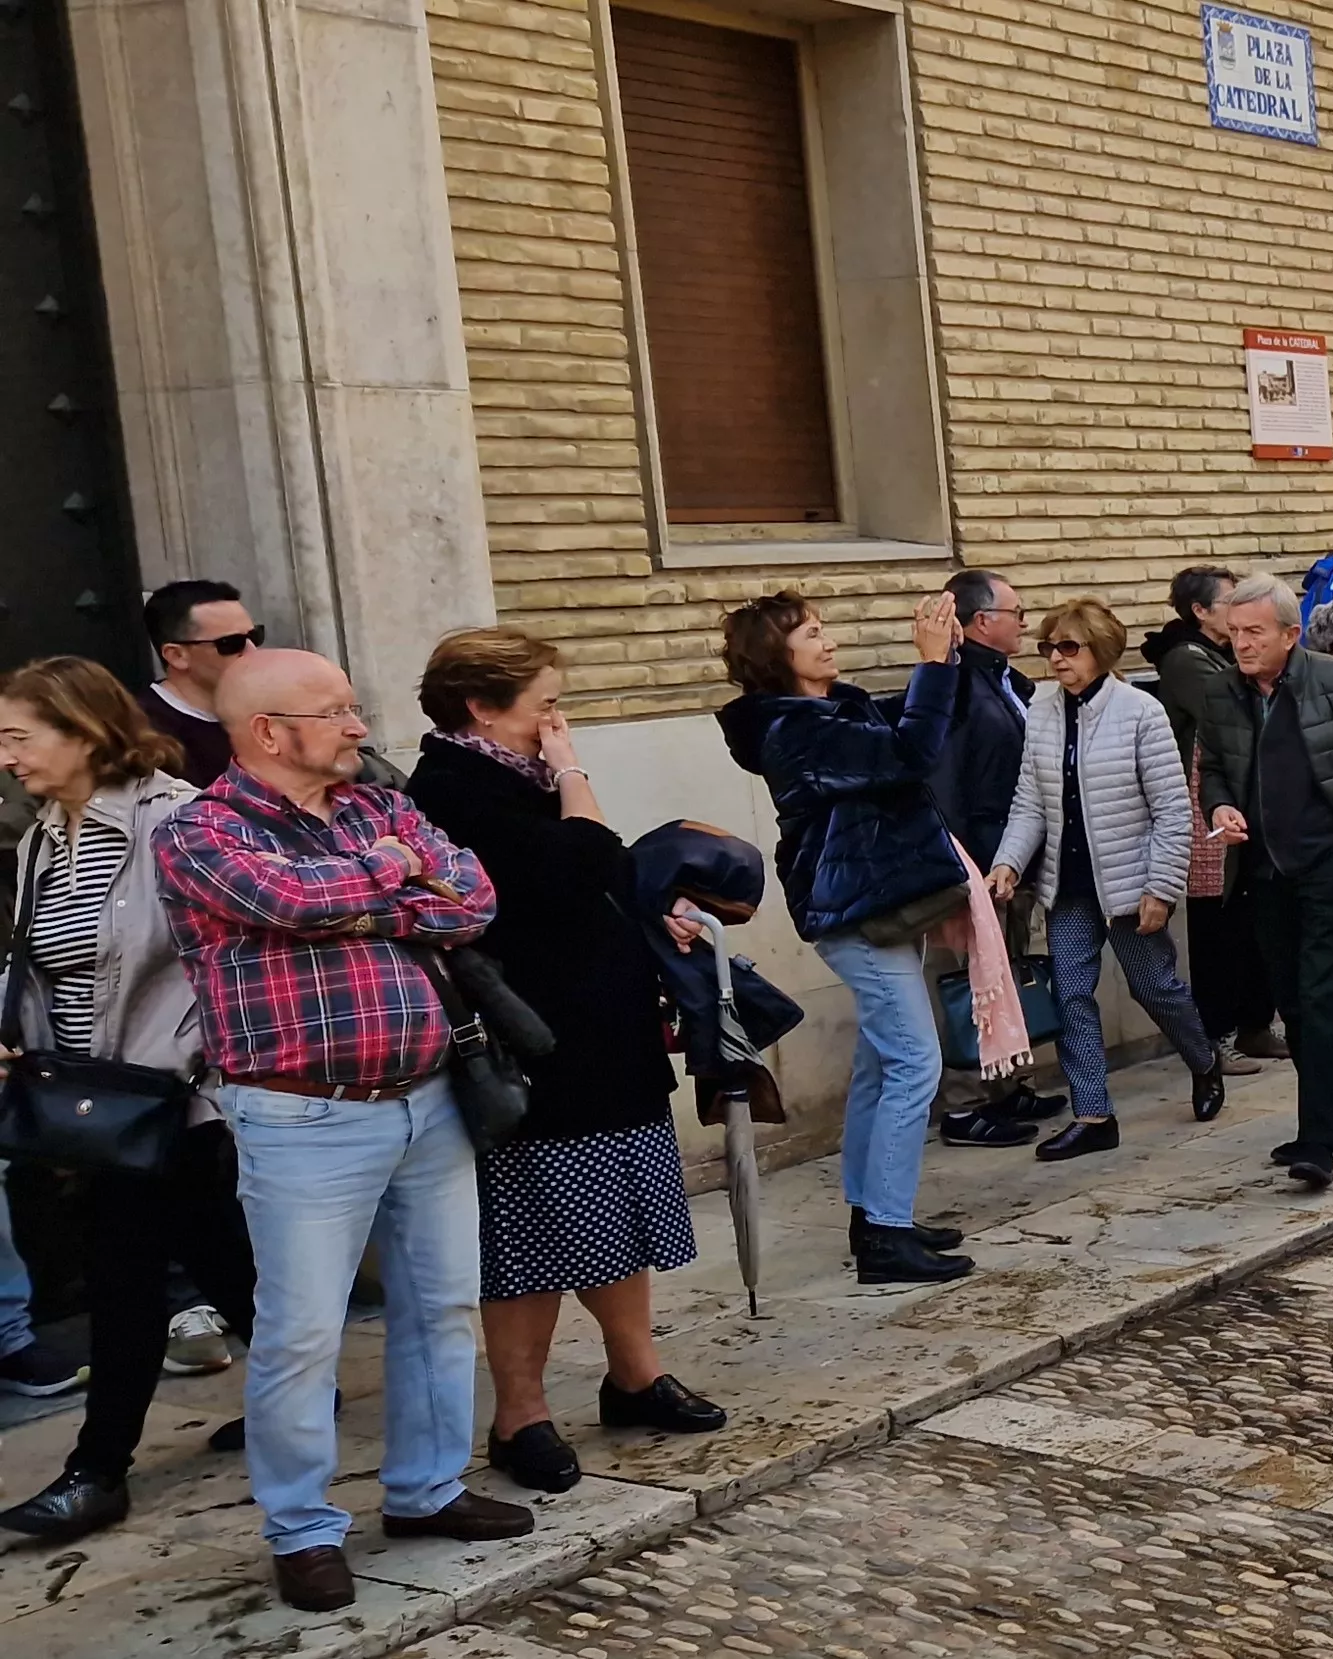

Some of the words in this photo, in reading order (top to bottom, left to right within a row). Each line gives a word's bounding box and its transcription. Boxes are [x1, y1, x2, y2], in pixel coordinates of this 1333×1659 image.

[1247, 35, 1293, 66] PLAZA
[1254, 66, 1271, 86] DE
[1275, 70, 1292, 92] LA
[1216, 83, 1303, 123] CATEDRAL
[1289, 336, 1320, 350] CATEDRAL
